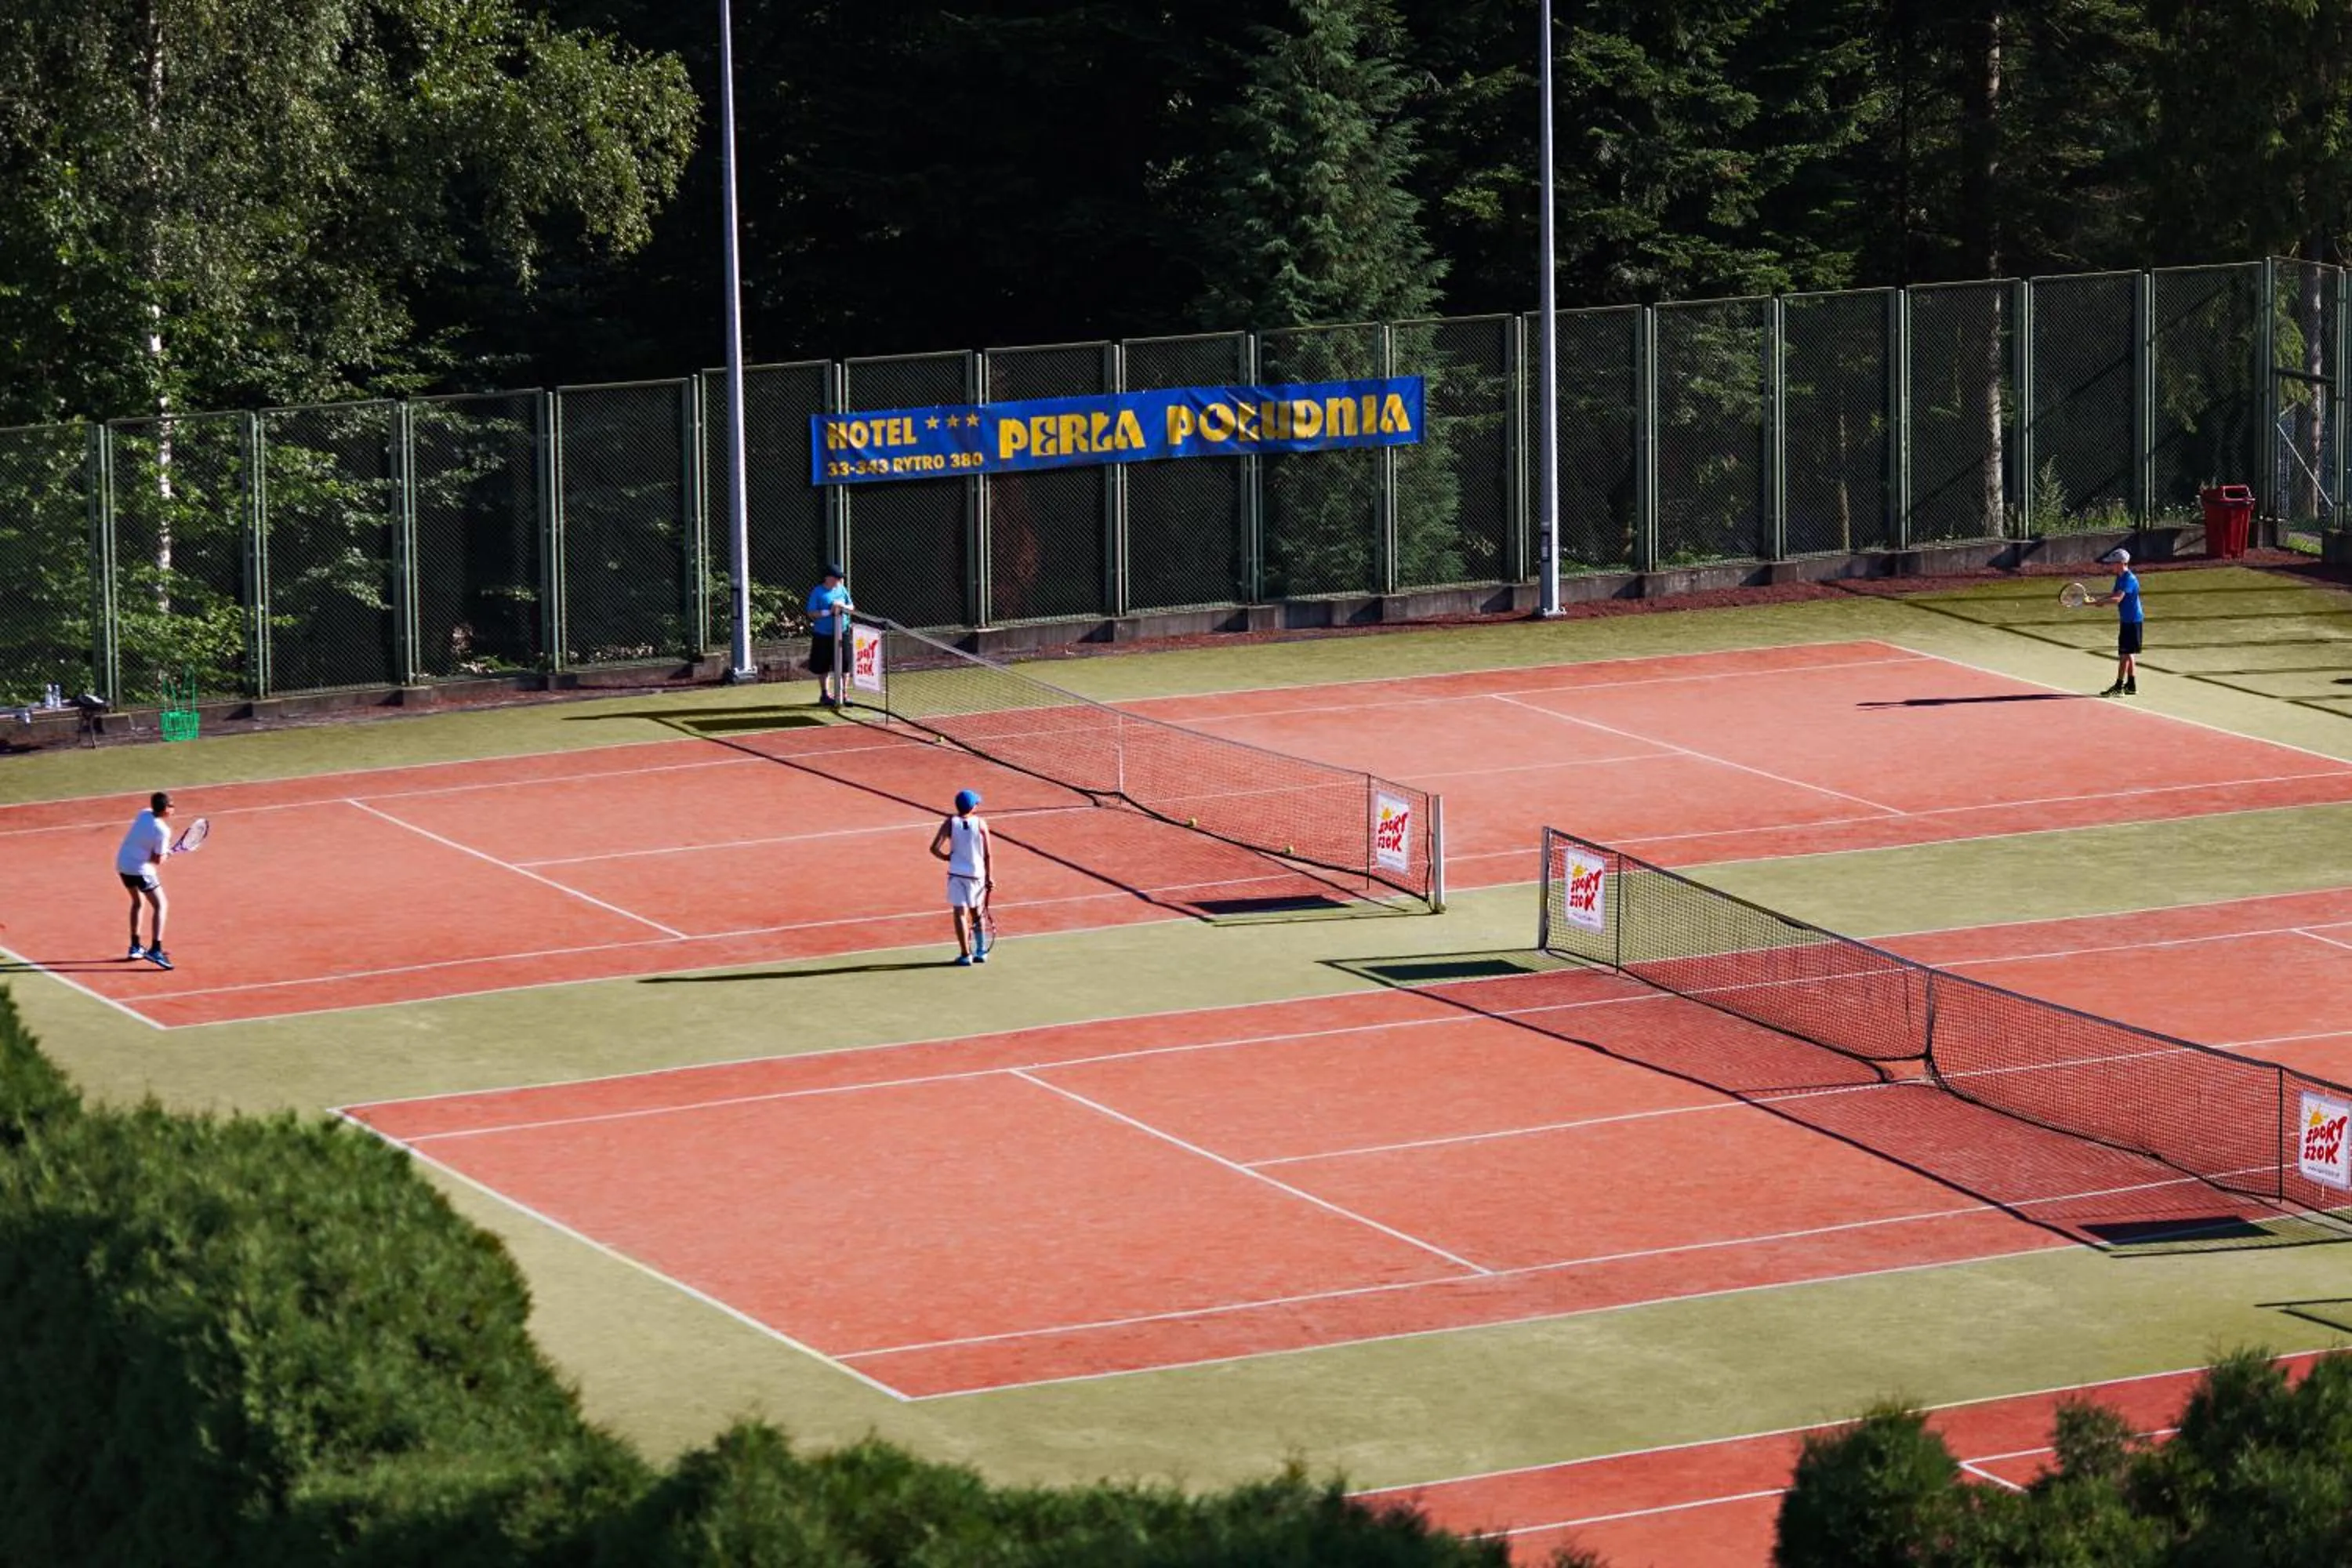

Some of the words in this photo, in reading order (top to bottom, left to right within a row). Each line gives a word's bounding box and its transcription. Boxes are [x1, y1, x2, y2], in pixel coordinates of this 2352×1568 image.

[827, 417, 916, 450] HOTEL
[999, 410, 1146, 459] PERŁA
[1167, 394, 1410, 445] POŁUDNIA
[893, 455, 944, 472] RYTRO
[951, 452, 982, 468] 380
[2306, 1116, 2347, 1144] SPORT
